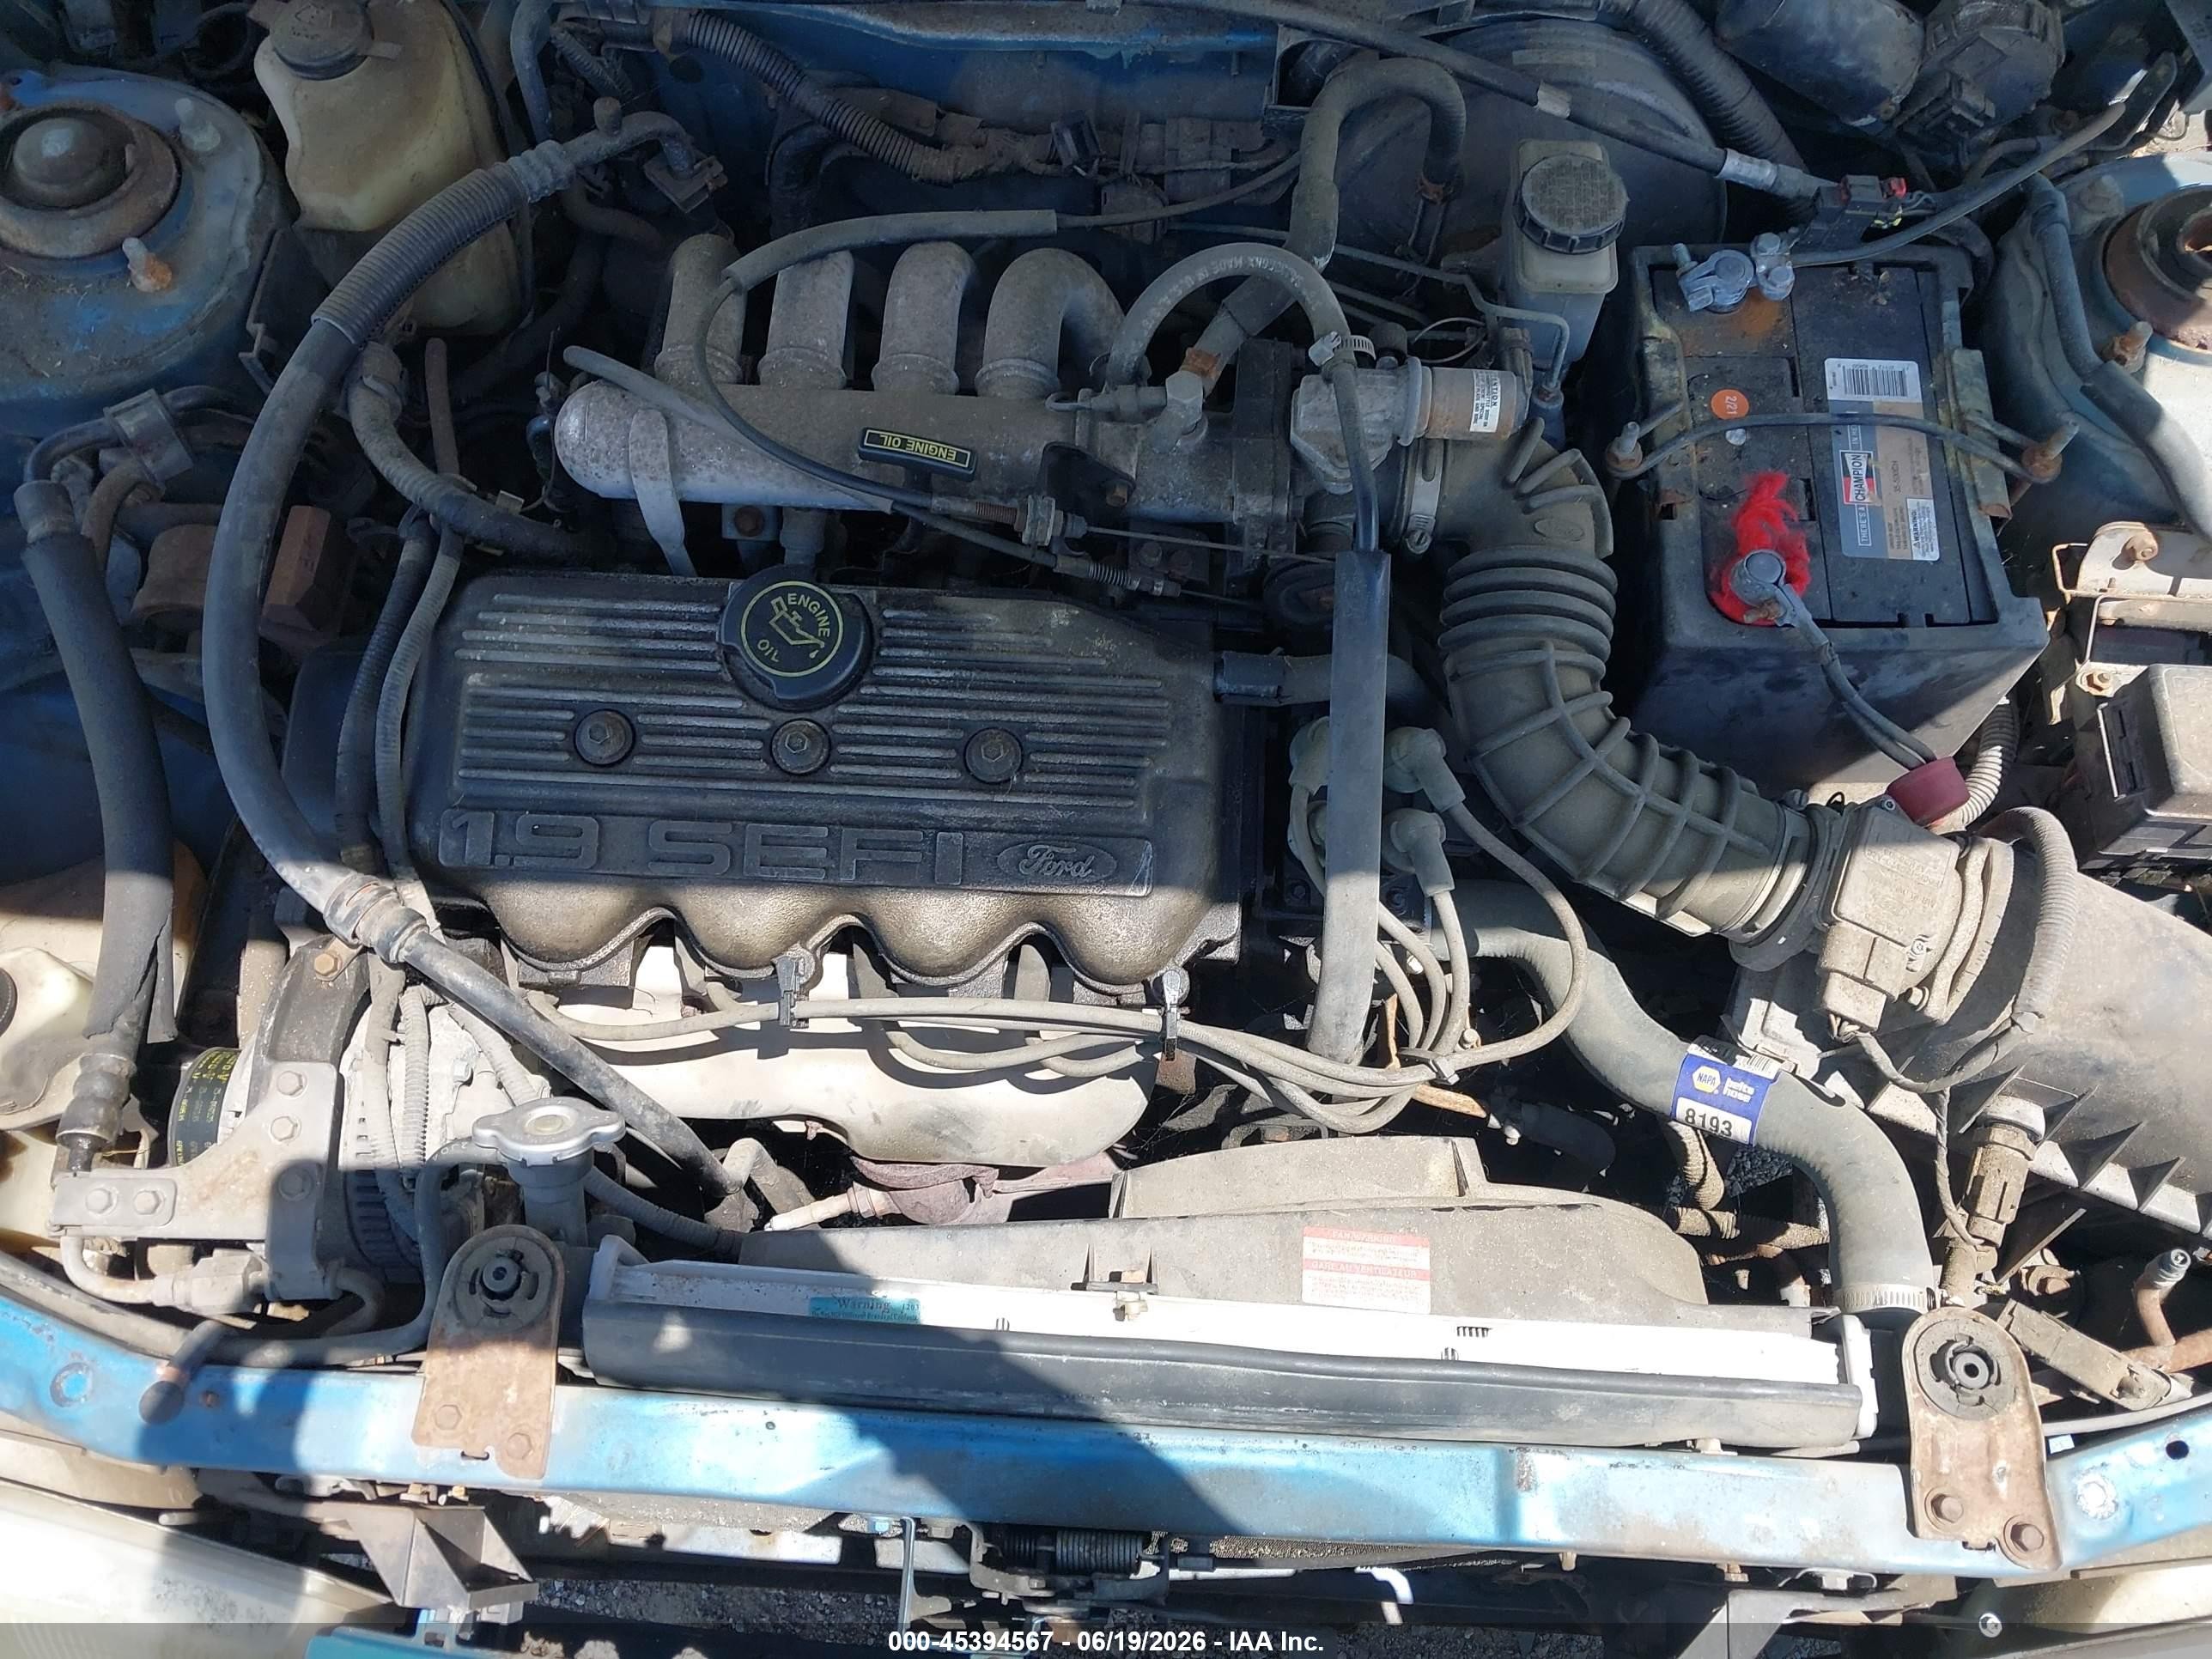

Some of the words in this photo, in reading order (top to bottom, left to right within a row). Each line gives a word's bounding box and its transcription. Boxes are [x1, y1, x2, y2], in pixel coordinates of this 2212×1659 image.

[880, 434, 902, 447] OIL
[906, 439, 957, 461] ENGINE
[1855, 454, 1866, 501] CHAMPION
[787, 592, 830, 638] ENGINE
[757, 639, 780, 663] OIL
[440, 811, 599, 870] 1.9
[647, 820, 963, 886] SEFI
[1018, 844, 1094, 879] Ford
[1697, 1073, 1717, 1085] NAPA
[1685, 1108, 1733, 1138] 8193
[837, 1297, 891, 1314] Warning
